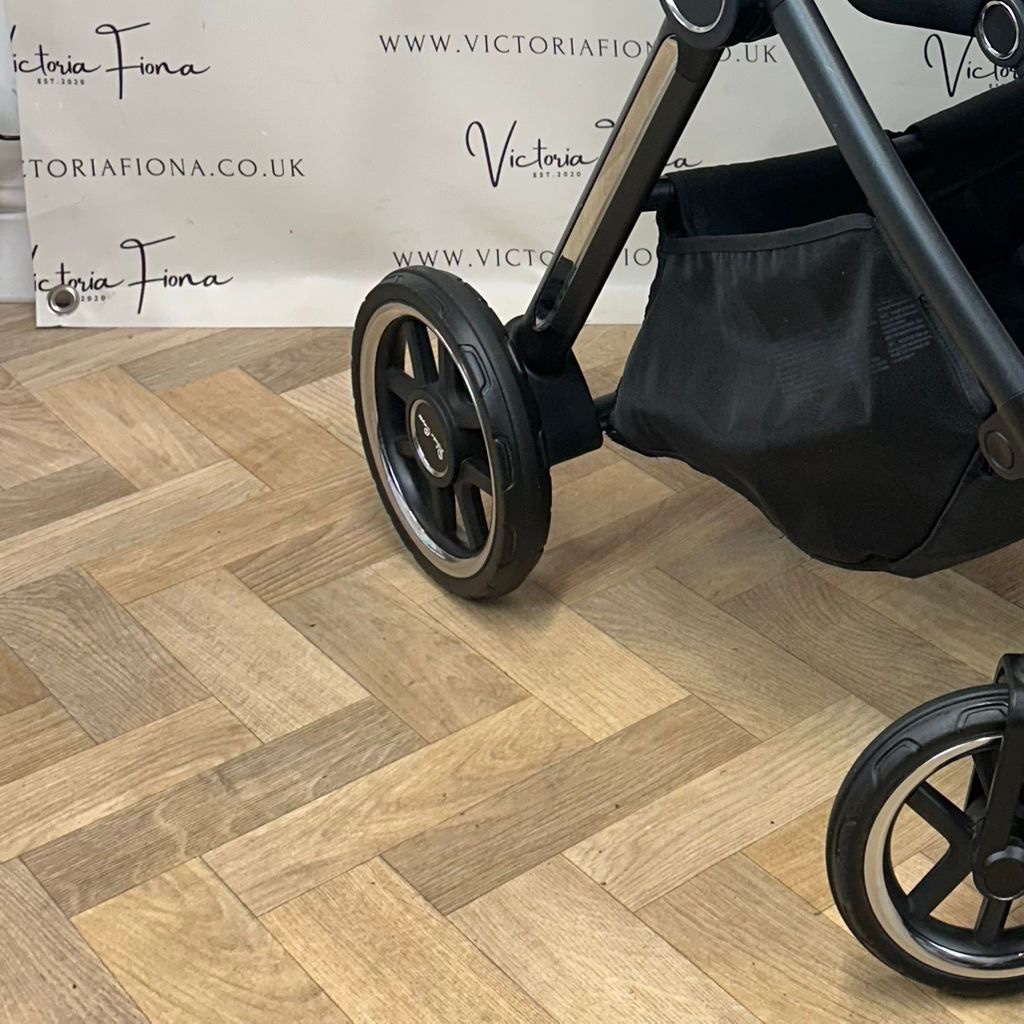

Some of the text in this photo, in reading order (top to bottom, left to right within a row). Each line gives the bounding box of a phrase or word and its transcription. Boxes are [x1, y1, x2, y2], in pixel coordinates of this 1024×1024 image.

[10, 22, 210, 100] ictoria Fiona
[37, 78, 86, 86] EST.2020
[21, 157, 305, 178] TORIAFIONA.CO.UK
[465, 120, 600, 188] Victoria
[120, 235, 234, 315] Fiona
